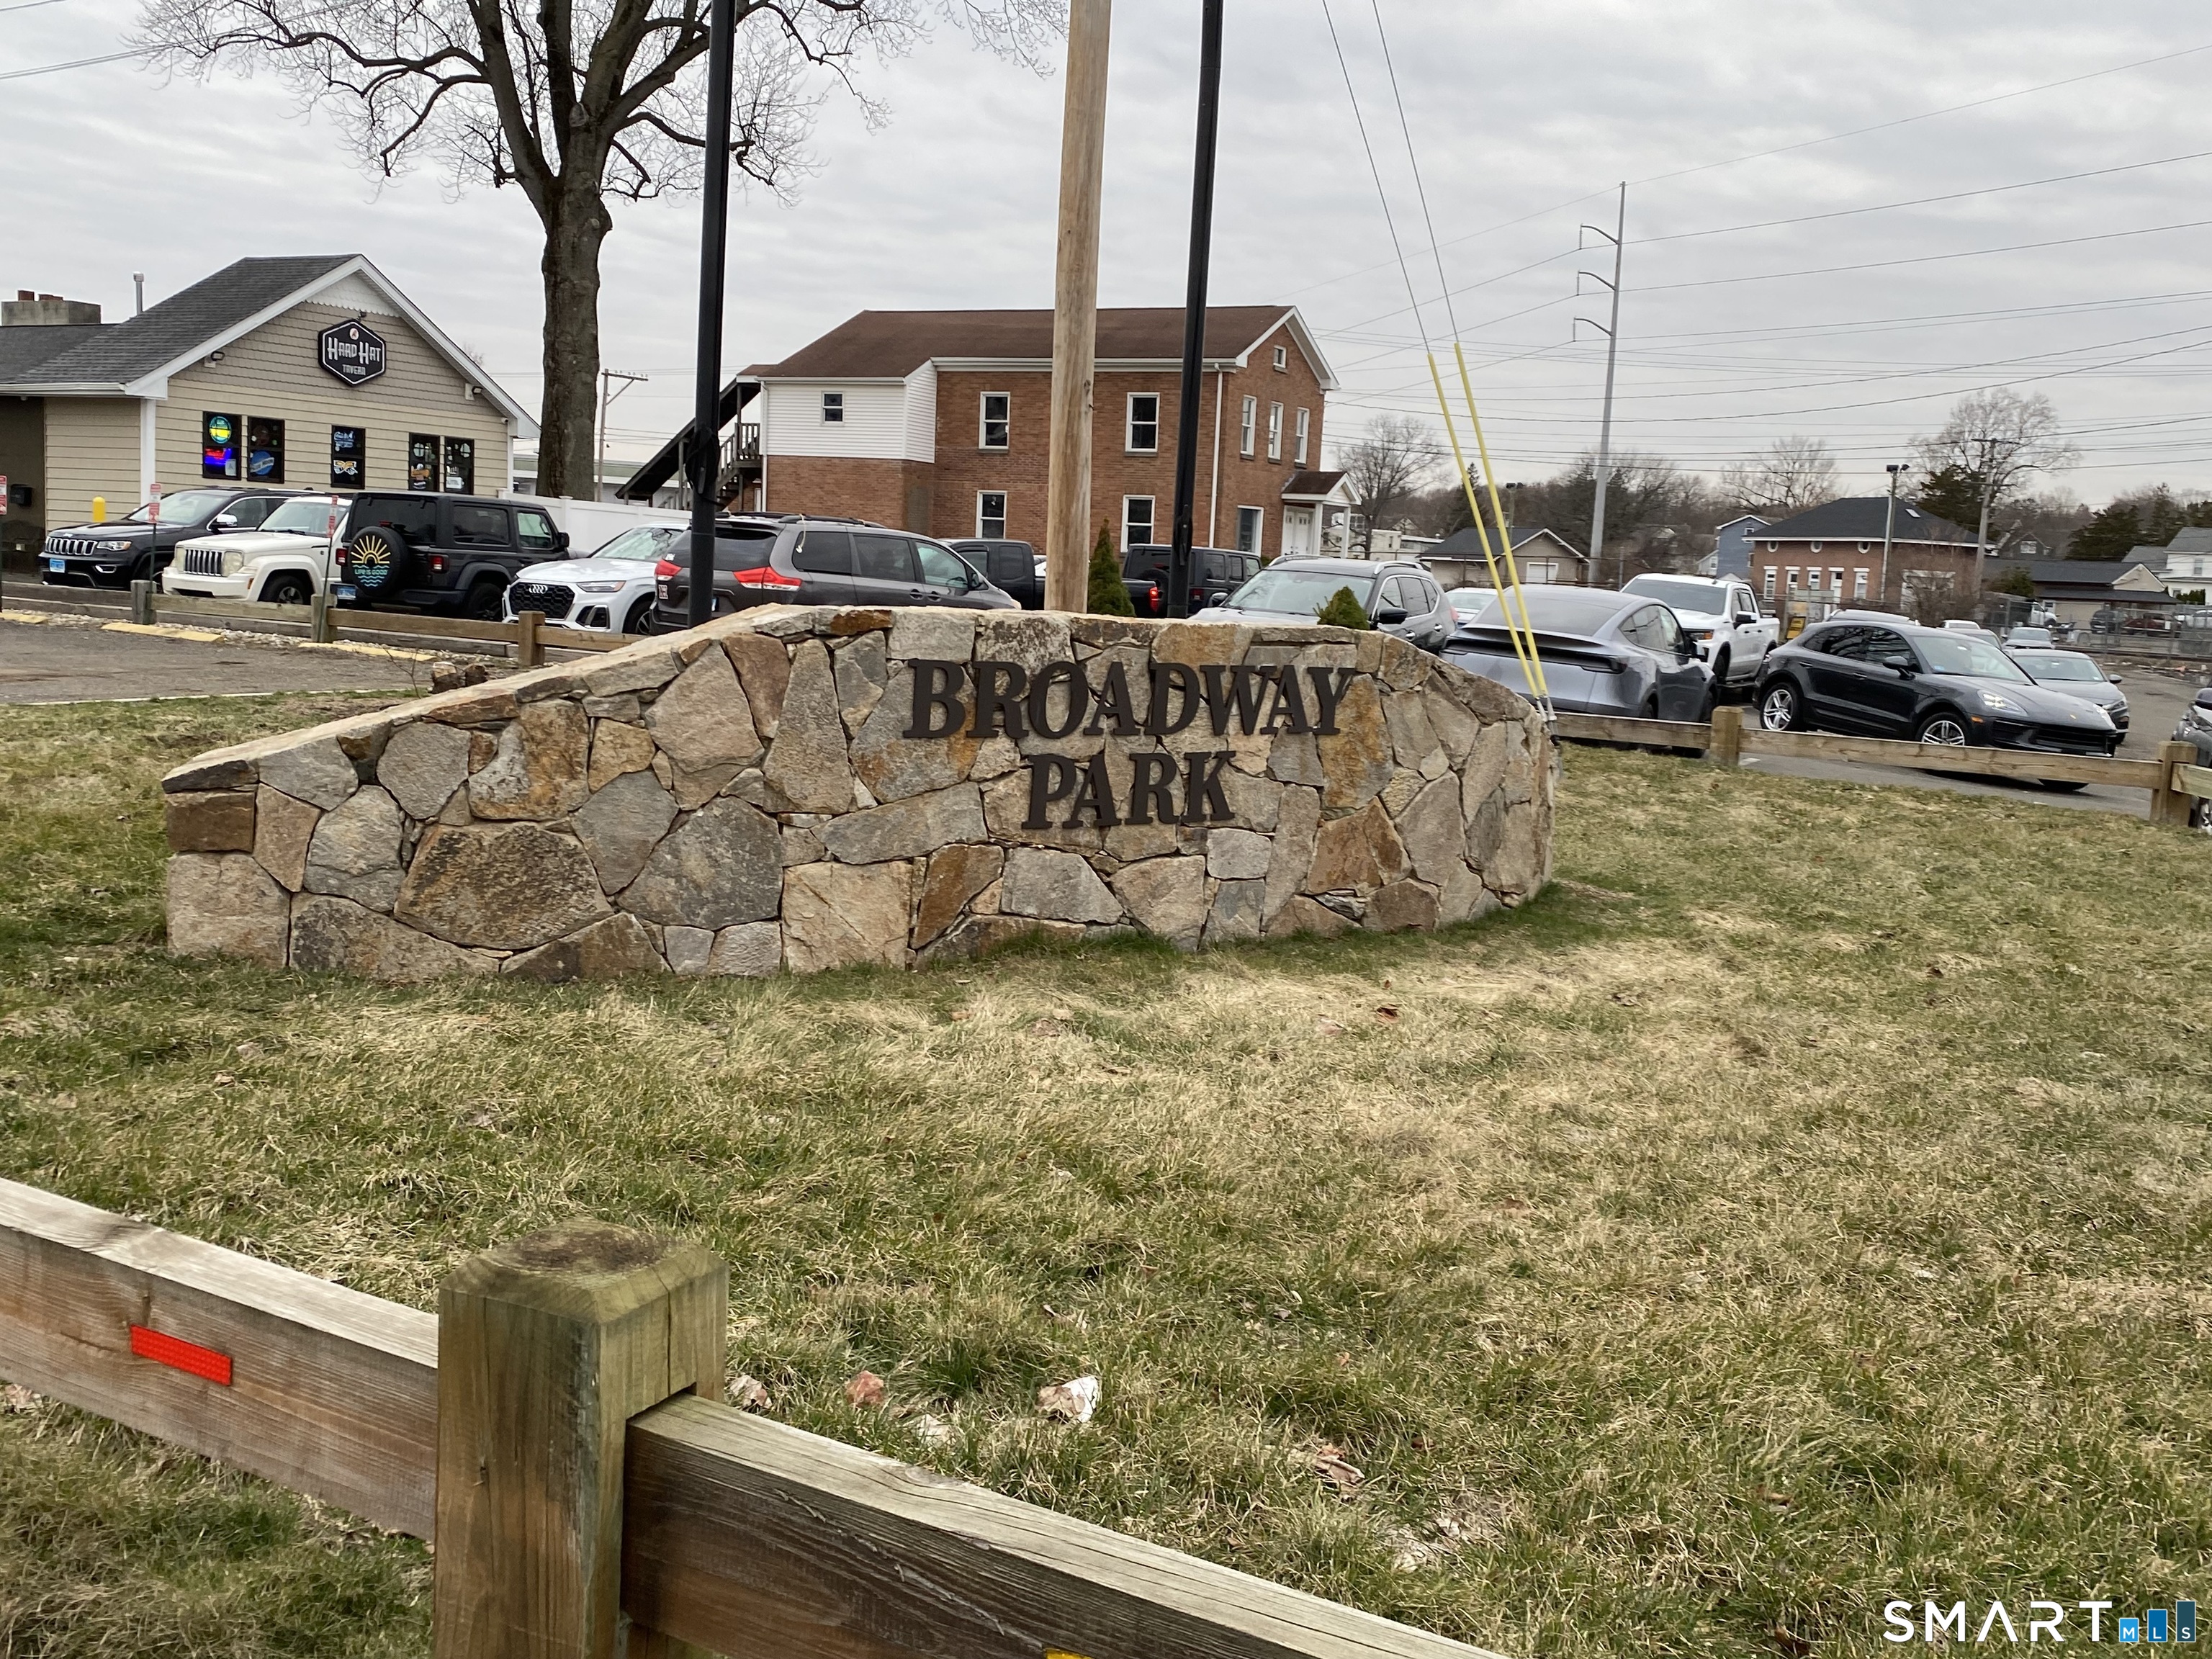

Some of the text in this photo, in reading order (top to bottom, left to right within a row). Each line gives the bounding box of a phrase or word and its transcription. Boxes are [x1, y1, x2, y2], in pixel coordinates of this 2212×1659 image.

[359, 341, 381, 364] HAT
[903, 658, 1354, 739] BROADWAY
[1022, 750, 1237, 830] PARK
